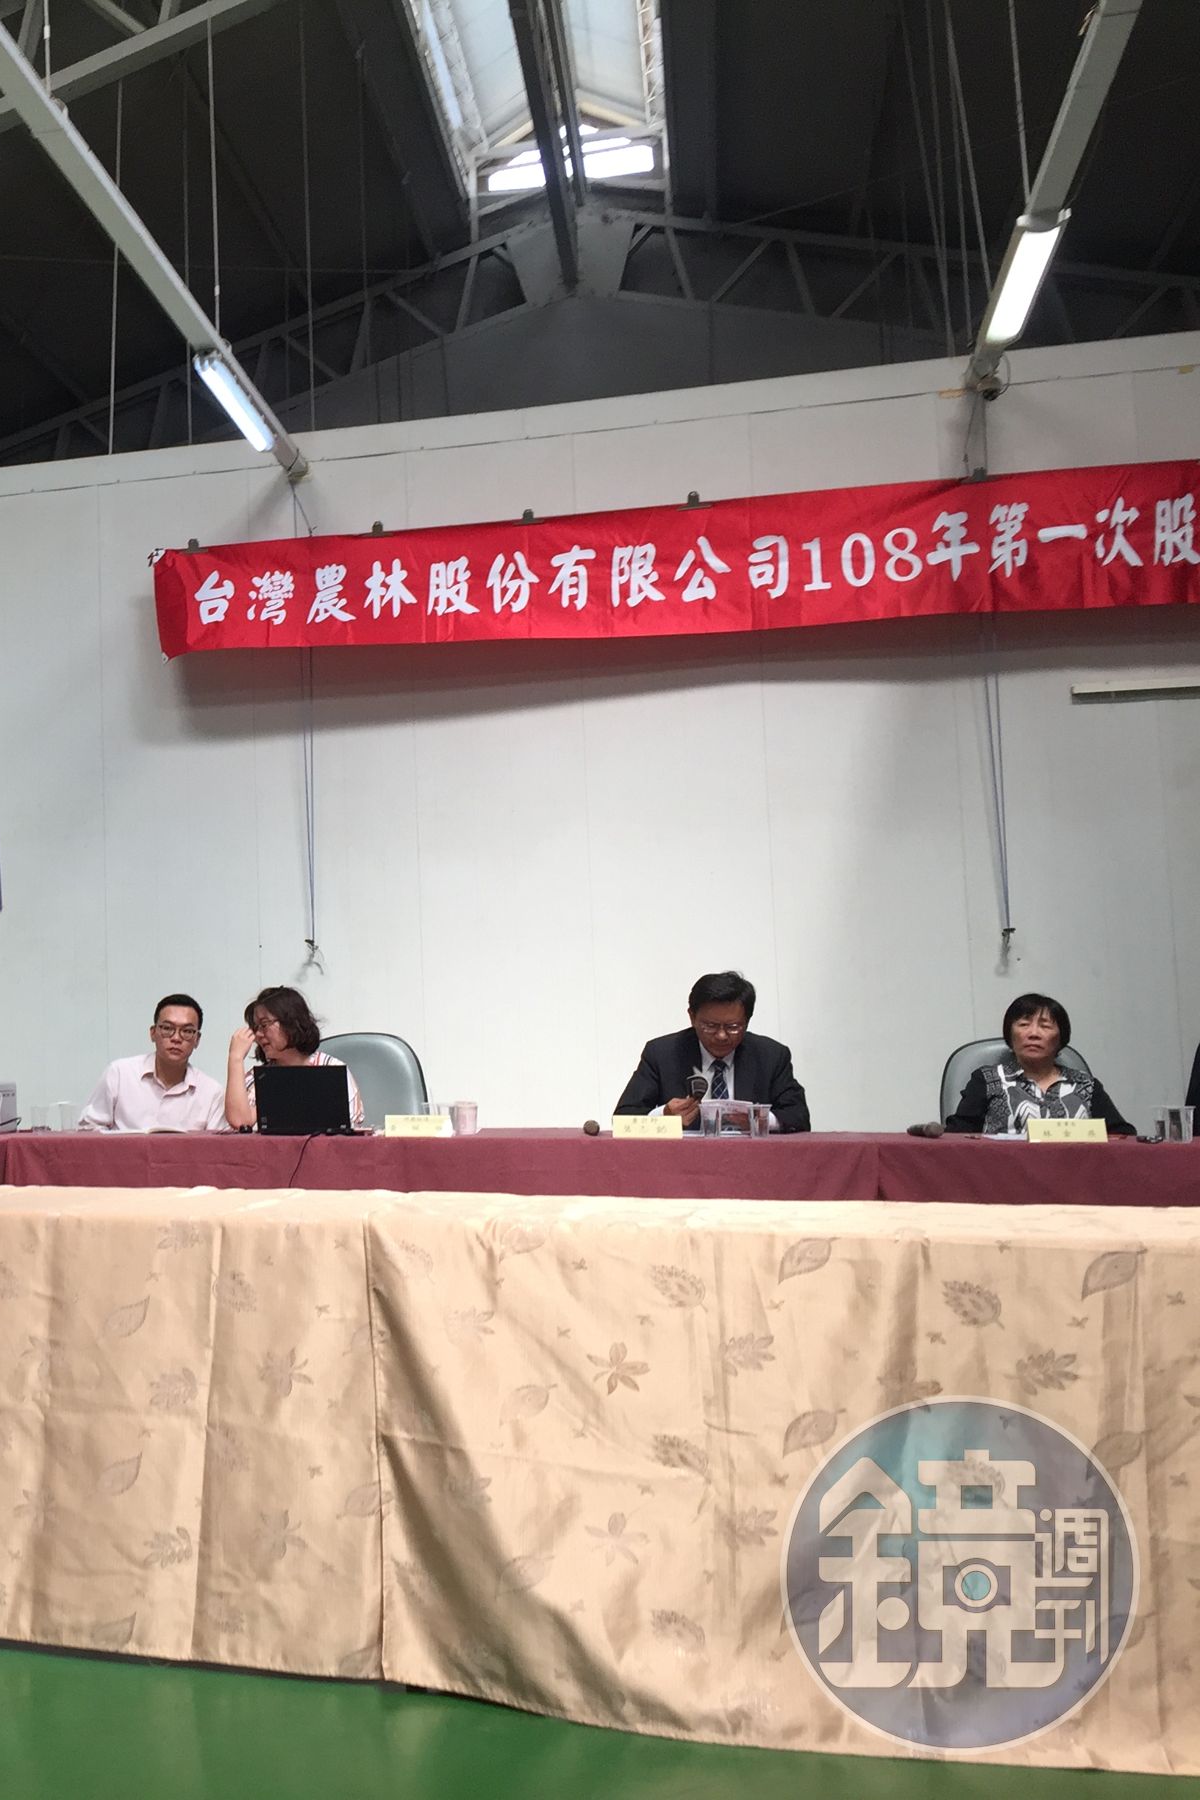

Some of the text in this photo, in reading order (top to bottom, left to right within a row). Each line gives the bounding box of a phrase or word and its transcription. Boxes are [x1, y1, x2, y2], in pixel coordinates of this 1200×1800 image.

[194, 493, 1200, 625] 台灣農林股份有限公司108年第一次股
